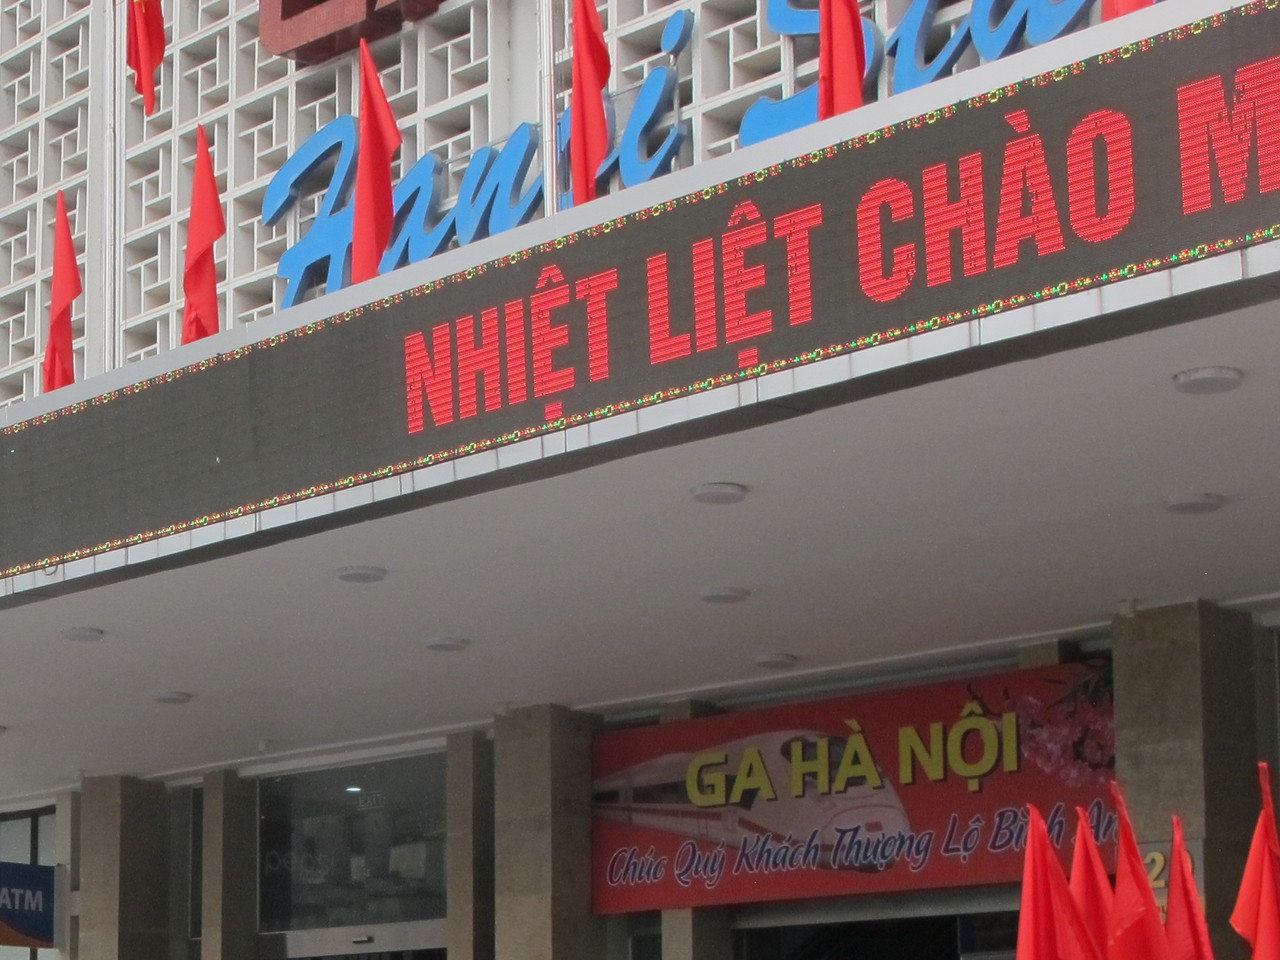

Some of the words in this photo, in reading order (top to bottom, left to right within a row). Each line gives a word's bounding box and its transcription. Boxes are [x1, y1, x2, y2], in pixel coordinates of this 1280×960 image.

[404, 264, 618, 434] NHIỆT
[646, 202, 823, 368] LIỆT
[856, 109, 1137, 303] CHÀO
[685, 746, 777, 809] GA
[789, 719, 885, 798] HÀ
[898, 700, 1021, 793] NỘI
[607, 844, 668, 887] Chúc
[674, 838, 727, 889] Quý
[732, 827, 820, 876] Khách
[830, 824, 935, 873] Thượng
[940, 803, 986, 864] Lộ
